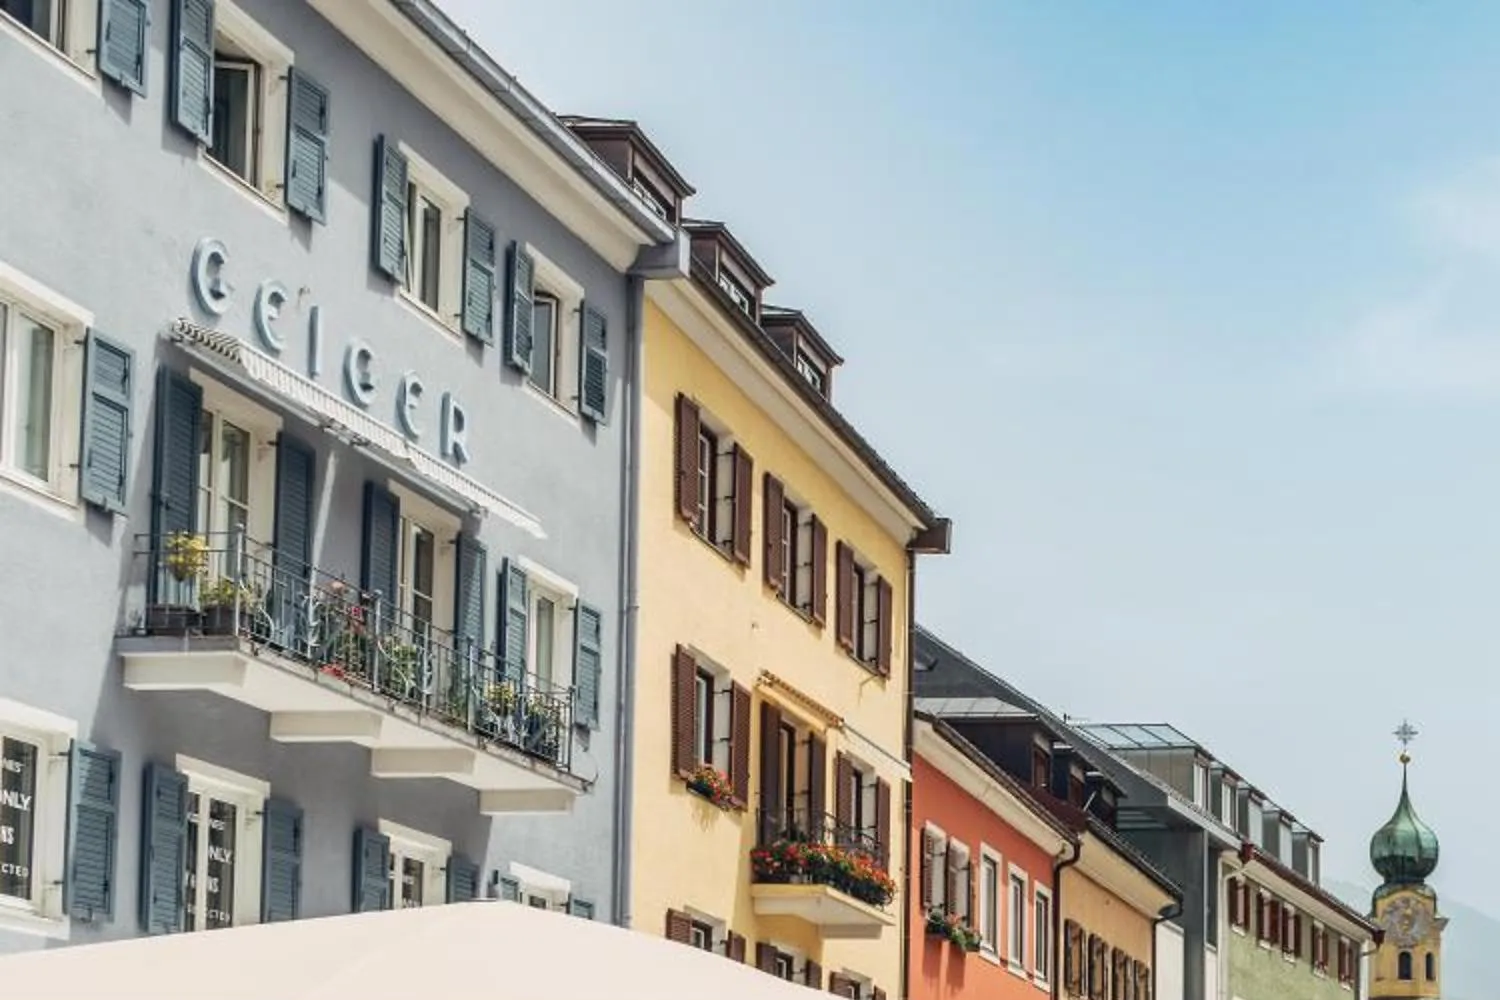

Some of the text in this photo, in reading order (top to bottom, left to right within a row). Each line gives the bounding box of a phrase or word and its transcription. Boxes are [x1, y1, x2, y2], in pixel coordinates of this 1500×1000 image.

[190, 237, 471, 465] GEIGER
[1, 789, 31, 812] NLY
[209, 845, 232, 865] NLY
